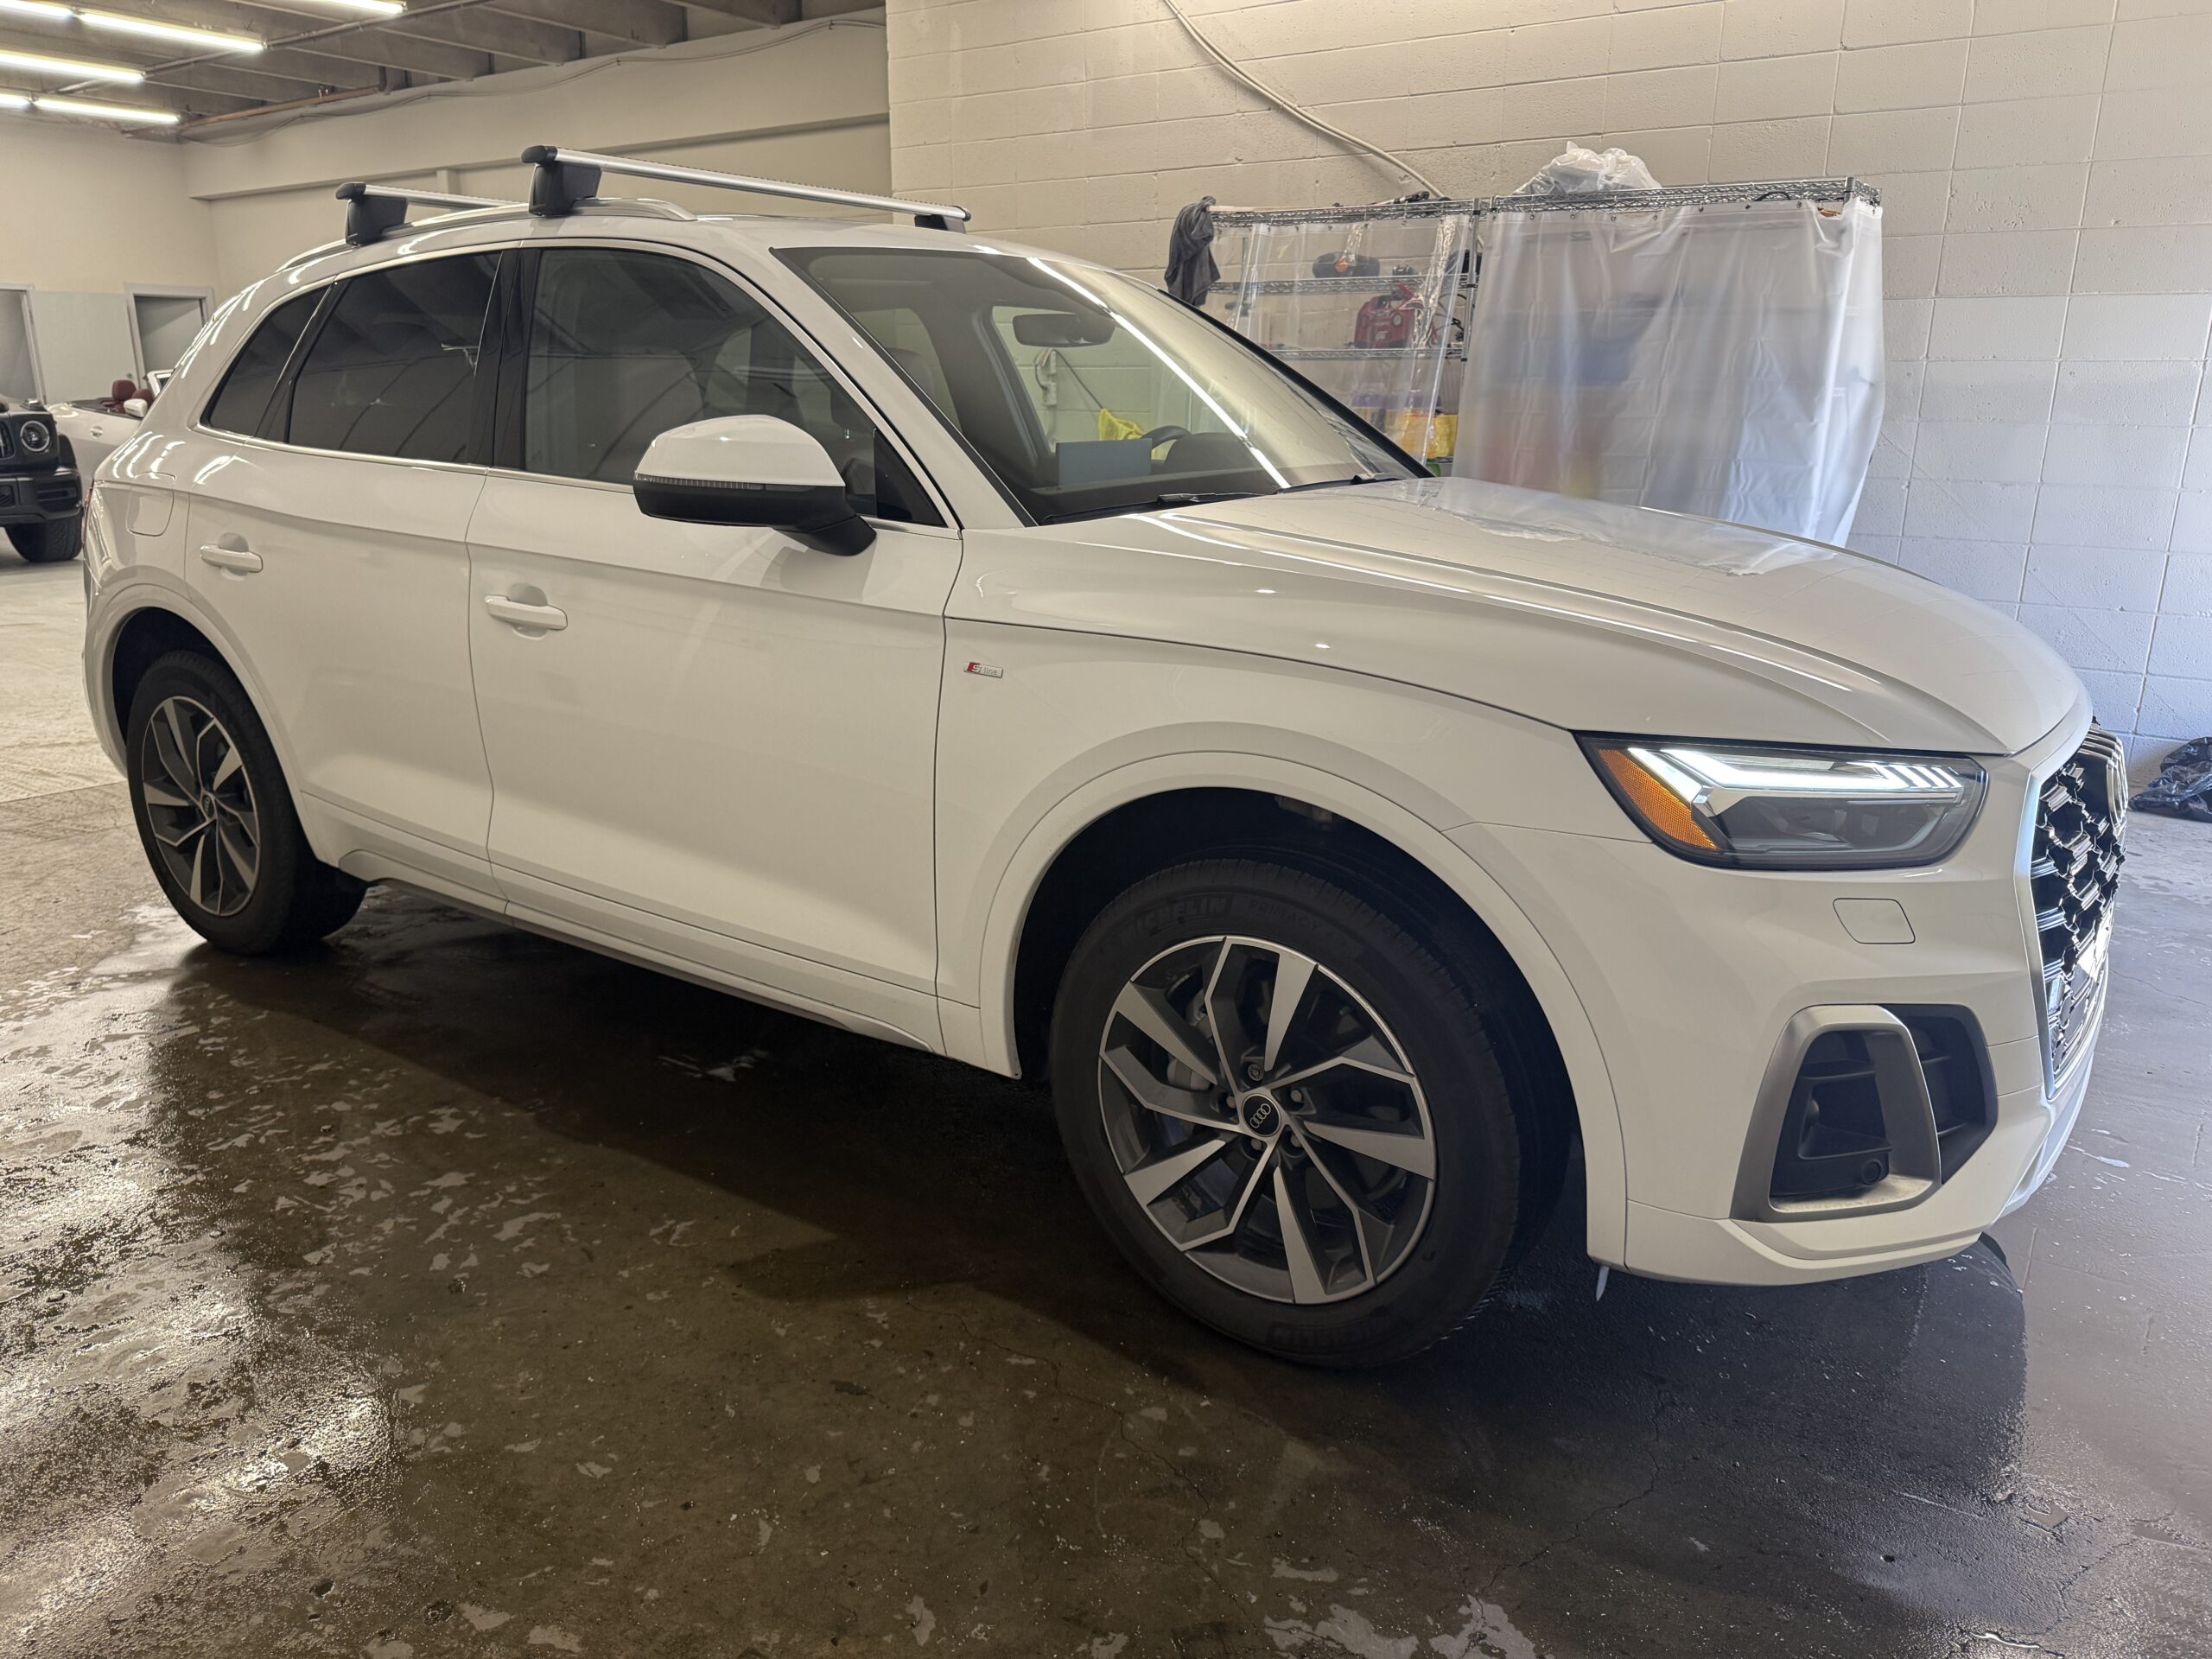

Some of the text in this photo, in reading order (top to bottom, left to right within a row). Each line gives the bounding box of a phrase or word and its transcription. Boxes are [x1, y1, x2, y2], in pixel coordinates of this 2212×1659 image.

[972, 664, 998, 676] S line
[1122, 897, 1319, 943] MICHELIN PRIMACY
